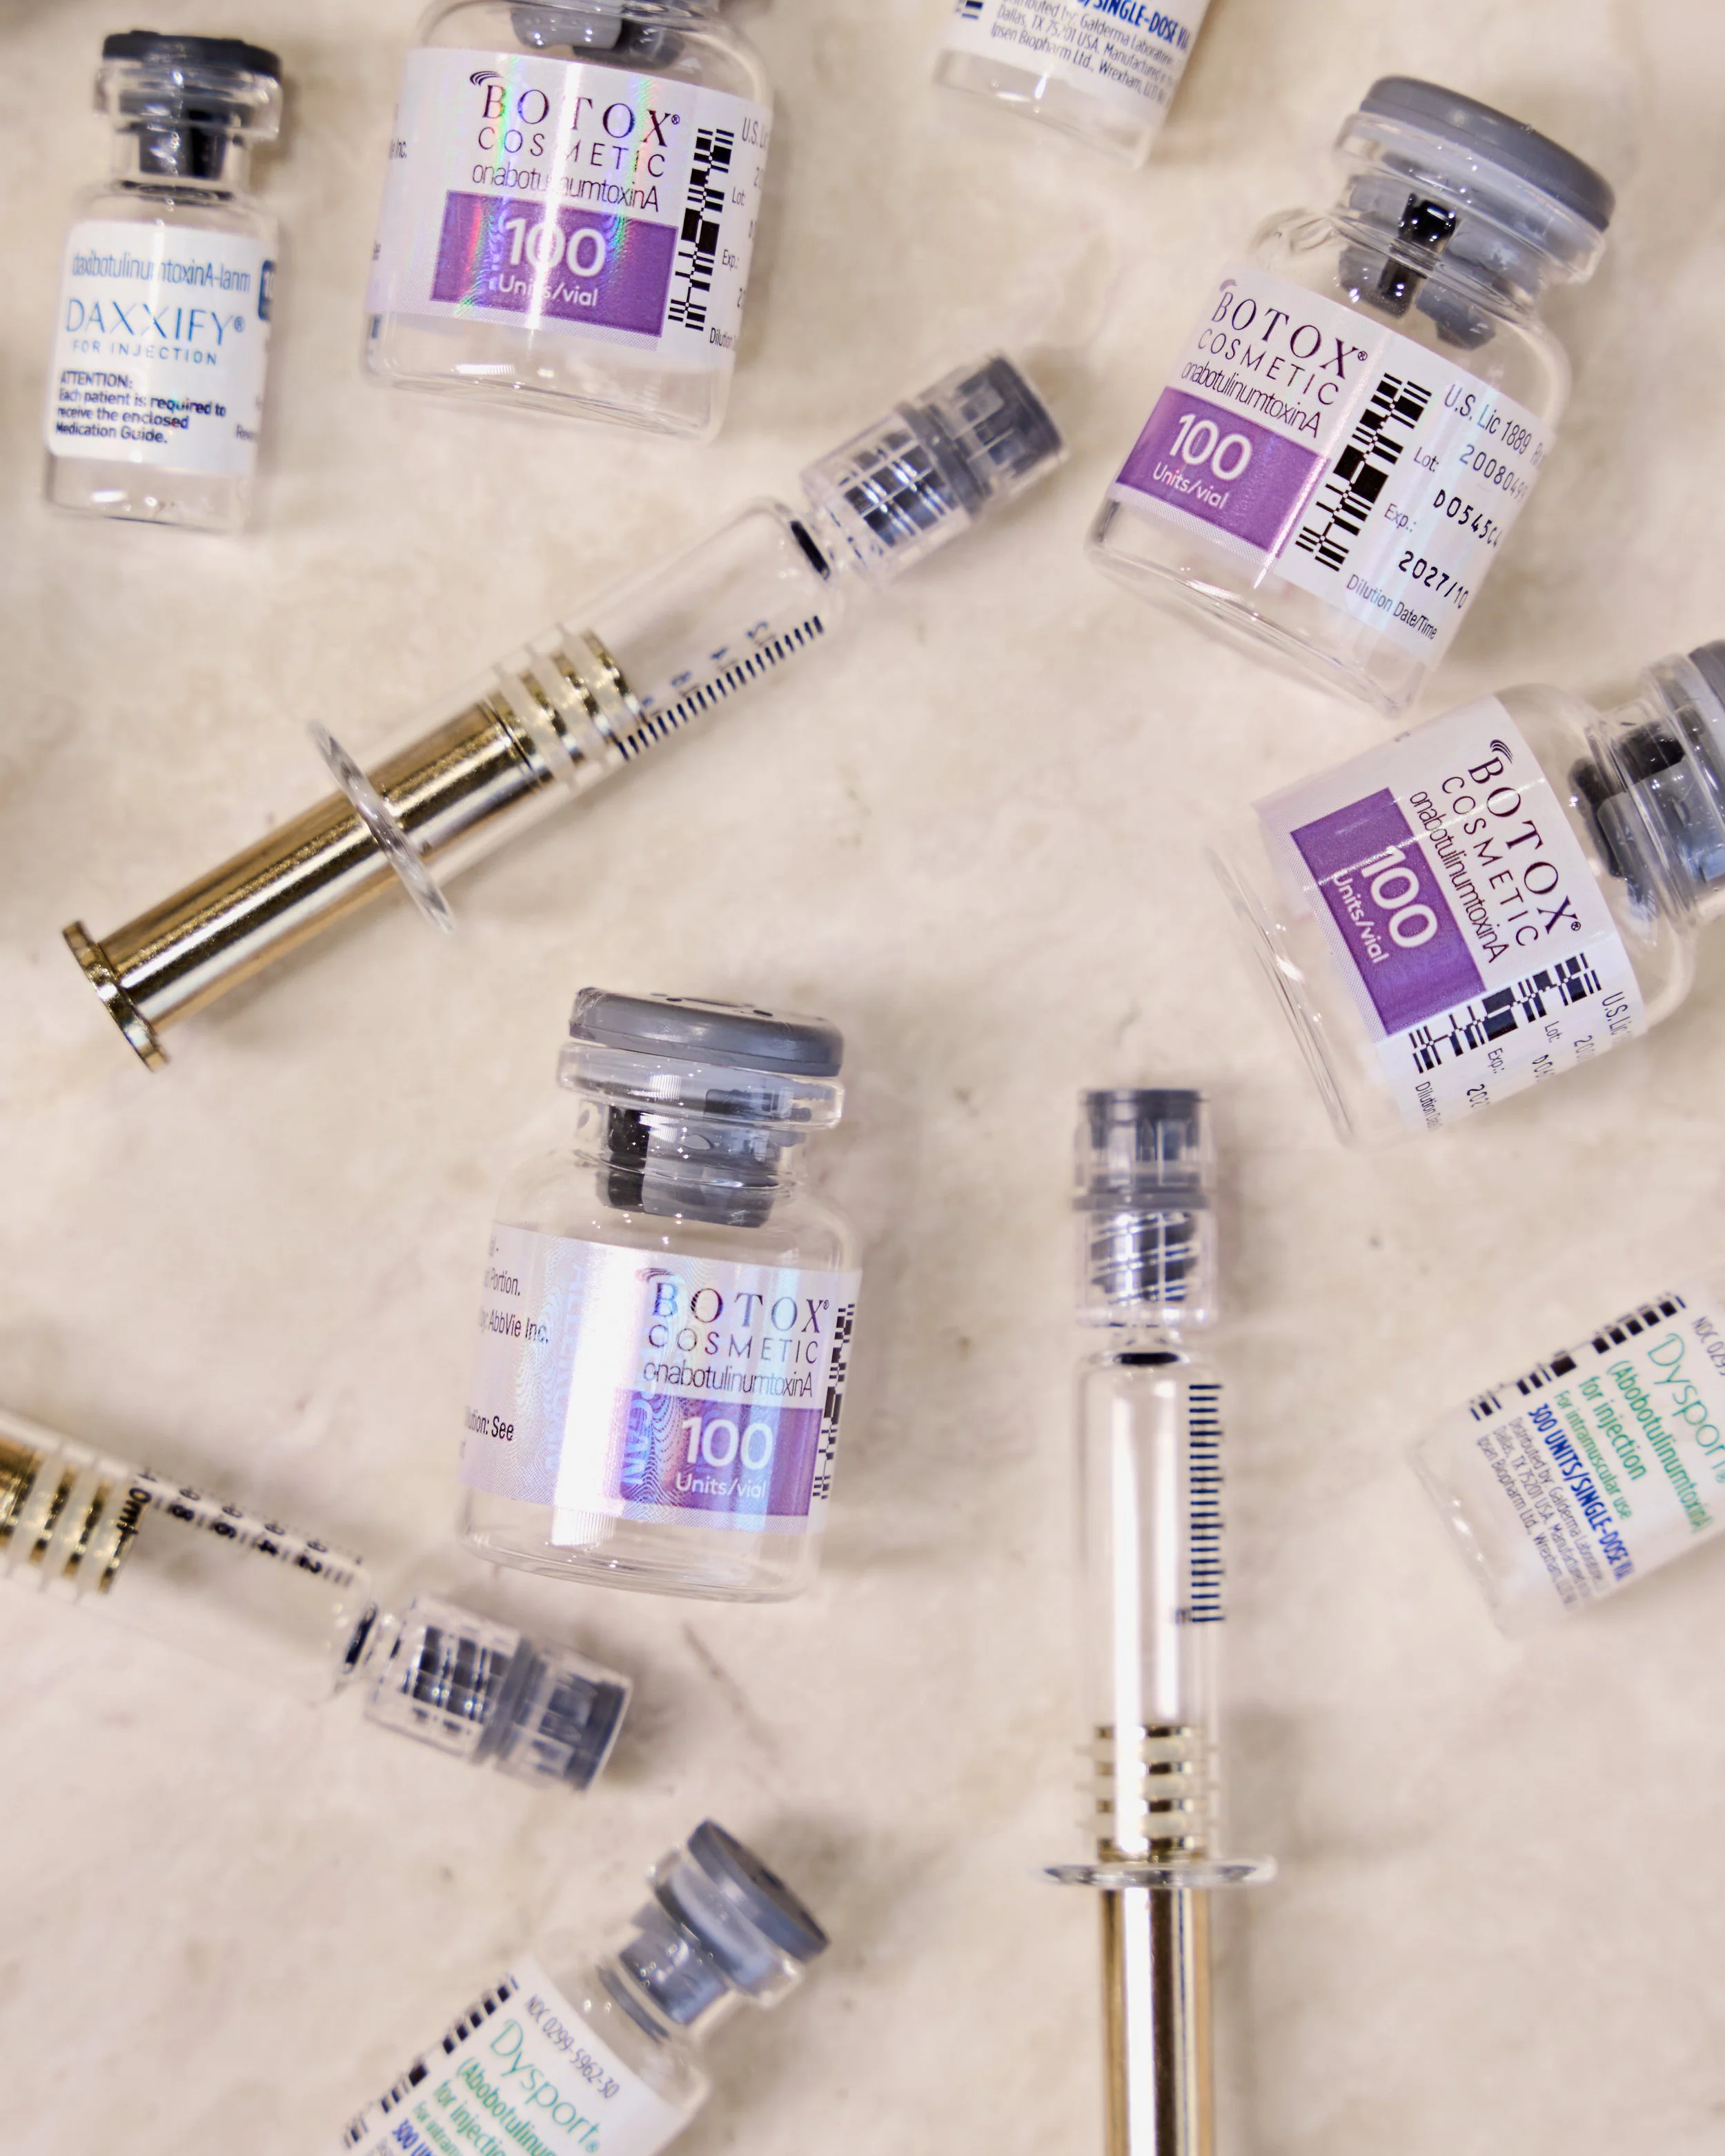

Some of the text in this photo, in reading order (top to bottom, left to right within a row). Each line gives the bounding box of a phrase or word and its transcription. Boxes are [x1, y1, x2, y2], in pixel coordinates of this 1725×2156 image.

[998, 4, 1027, 28] Dallas,
[1032, 14, 1045, 32] TX
[1081, 13, 1130, 46] Galderma
[992, 21, 1018, 41] Ipsen
[1018, 29, 1072, 61] Biopharm
[502, 217, 607, 278] 100
[497, 272, 599, 308] Unis/vial
[72, 339, 217, 366] FOR INJECTION
[1198, 328, 1339, 406] COSMETIC
[59, 370, 133, 390] ATTENTION:
[57, 406, 190, 430] receive the enclosed
[59, 388, 227, 417] Each patient is required to
[1181, 361, 1321, 439] onabotulinumtoxinA
[1444, 384, 1476, 422] U.S.
[1477, 404, 1501, 435] Lic
[1501, 420, 1532, 455] 1889
[55, 422, 168, 444] Medication Guide.
[1169, 413, 1252, 481] 100
[1413, 446, 1439, 473] Lot:
[1152, 461, 1230, 511] Units/vial
[1383, 502, 1417, 533] Exp.:
[1397, 550, 1470, 611] 2027/10
[1346, 573, 1439, 641] Dilution Date/Time
[1408, 790, 1510, 964] onabotulinumtoxinA
[1441, 775, 1539, 947] COSMETIC
[1359, 844, 1439, 949] 100
[1331, 873, 1390, 964] Units/vial
[1601, 991, 1628, 1022] U.S.
[1544, 1020, 1563, 1043] Lot:
[1487, 1047, 1506, 1074] Exp.:
[524, 1316, 549, 1344] Inc.
[648, 1324, 819, 1365] COSMETIC
[643, 1360, 814, 1398] onabotulinumtoxinA
[491, 1415, 515, 1442] See
[680, 1415, 774, 1471] 100
[1578, 1375, 1648, 1481] for injection
[1511, 1454, 1528, 1472] TX
[1553, 1389, 1633, 1520] For intramuscular use
[675, 1470, 766, 1499] Units/vial
[1491, 1458, 1527, 1511] Biopharm
[1509, 1416, 1549, 1470] Distributed
[1548, 1486, 1583, 1539] Galderma
[1518, 1469, 1544, 1499] 75201
[1528, 1403, 1557, 1433] 300
[1544, 1429, 1629, 1566] UNITS/SINGLE-DOSE
[542, 2015, 621, 2099] 0299-5962-30
[432, 2079, 458, 2109] for
[391, 2117, 420, 2150] 300
